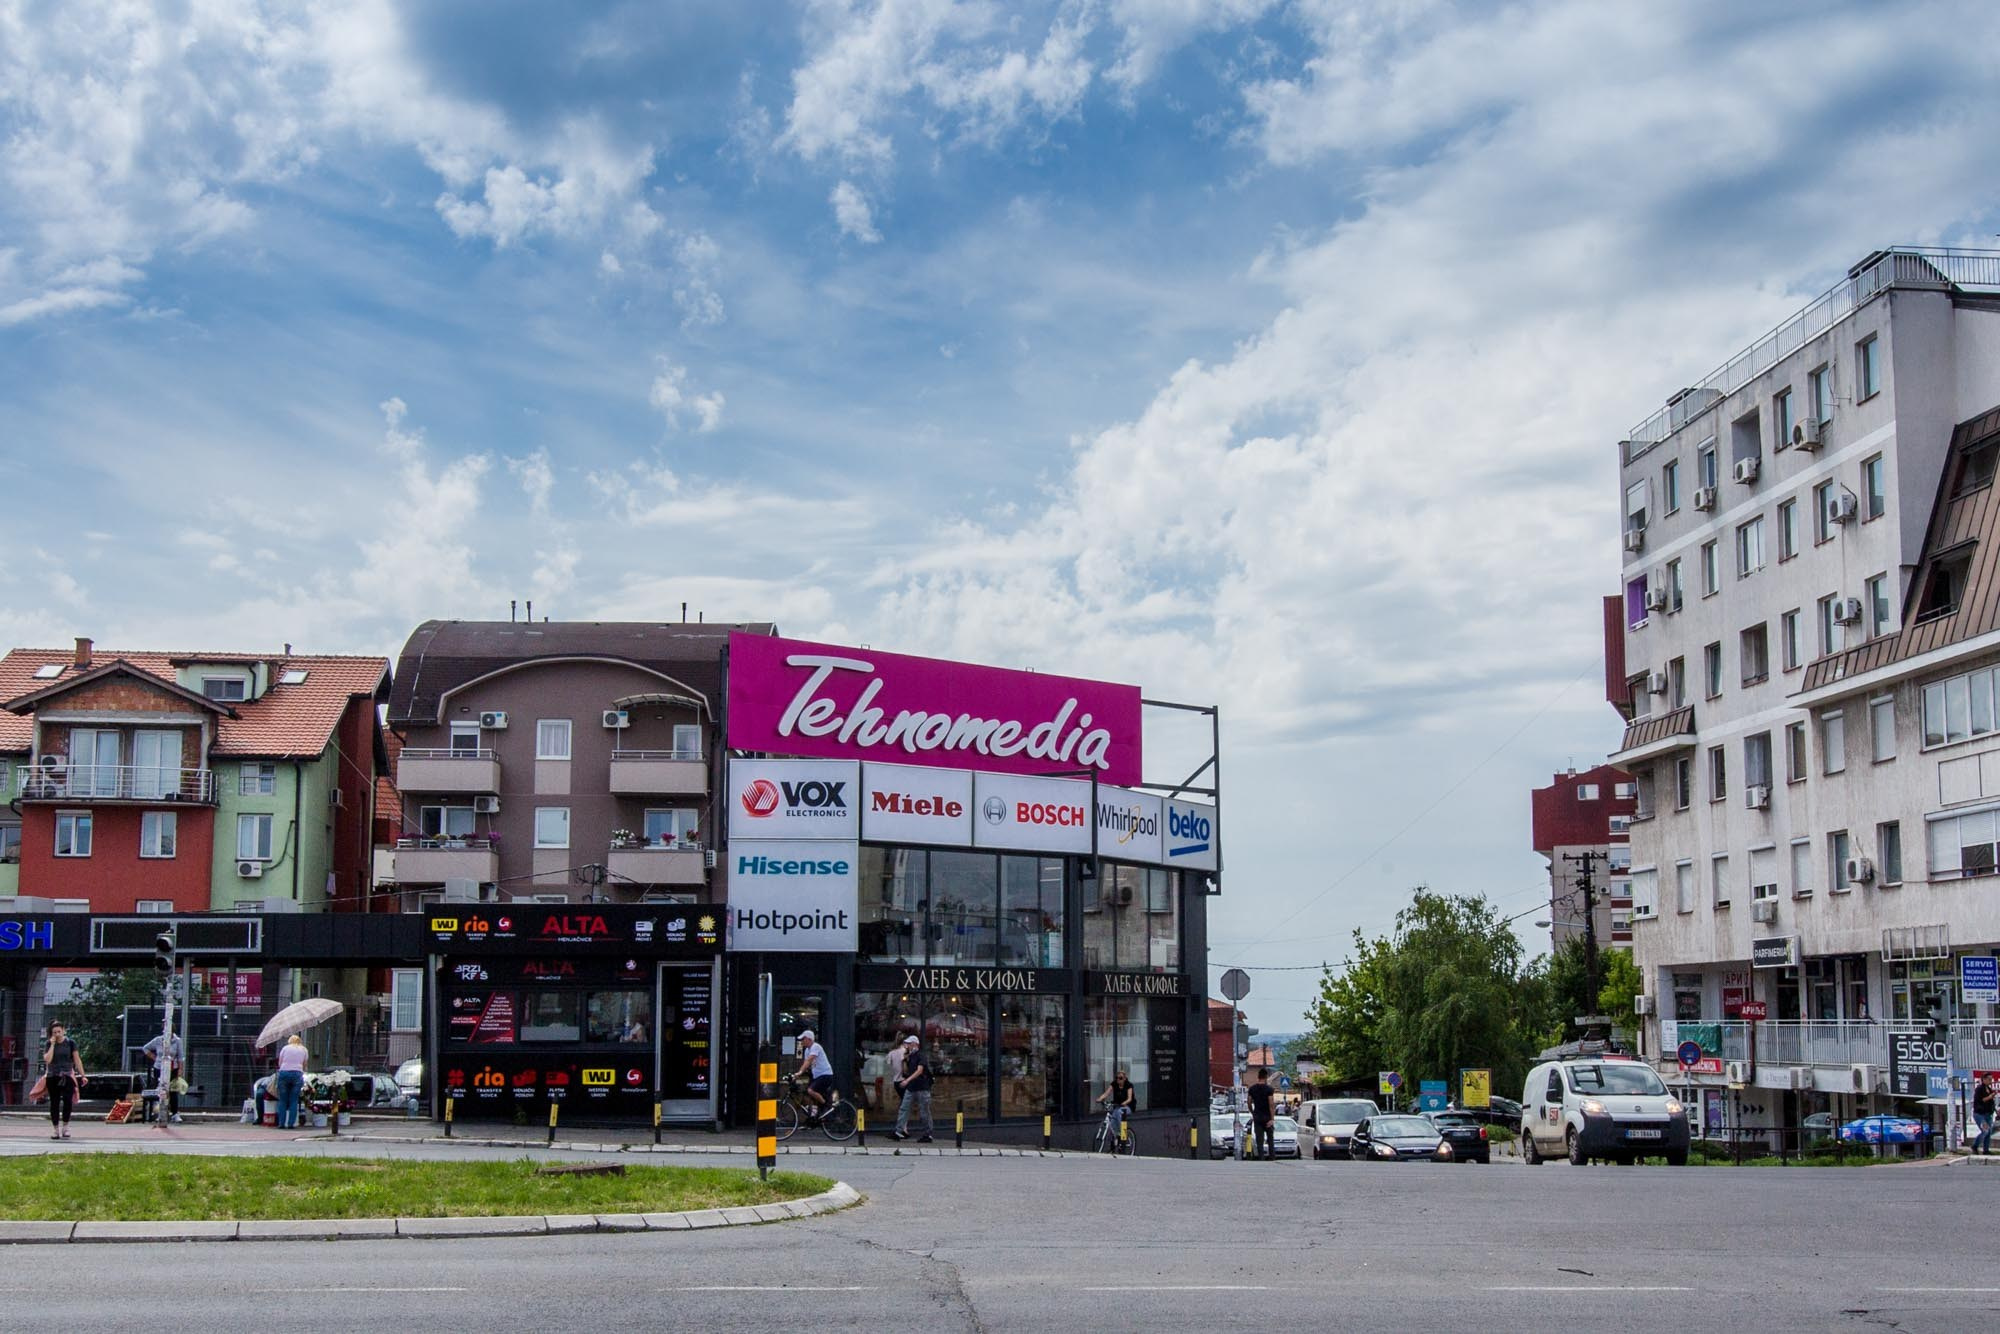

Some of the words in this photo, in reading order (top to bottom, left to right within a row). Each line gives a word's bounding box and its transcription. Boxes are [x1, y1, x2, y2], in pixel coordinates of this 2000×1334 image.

[778, 654, 1110, 770] Tehnomedia
[781, 781, 847, 807] VOX
[872, 791, 963, 818] Miele
[786, 809, 847, 817] ELECTRONICS
[1017, 802, 1085, 827] BOSCH
[1097, 802, 1158, 840] Whirlpool
[1169, 806, 1210, 841] beko
[738, 856, 849, 875] Hisense
[464, 915, 489, 932] ria
[542, 915, 608, 934] ALTA
[737, 908, 848, 935] Hotpoint
[1966, 960, 1993, 968] SERVIS
[904, 969, 950, 989] ХЛЕБ
[956, 969, 970, 990] &
[976, 970, 1035, 991] КИФЛЕ
[1105, 974, 1131, 993] ХЛЕБ
[1133, 976, 1142, 993] &
[1144, 975, 1178, 995] КИФЛЕ
[1741, 1006, 1766, 1016] АРИЉЕ
[474, 1066, 505, 1086] ria
[588, 1072, 611, 1082] WU
